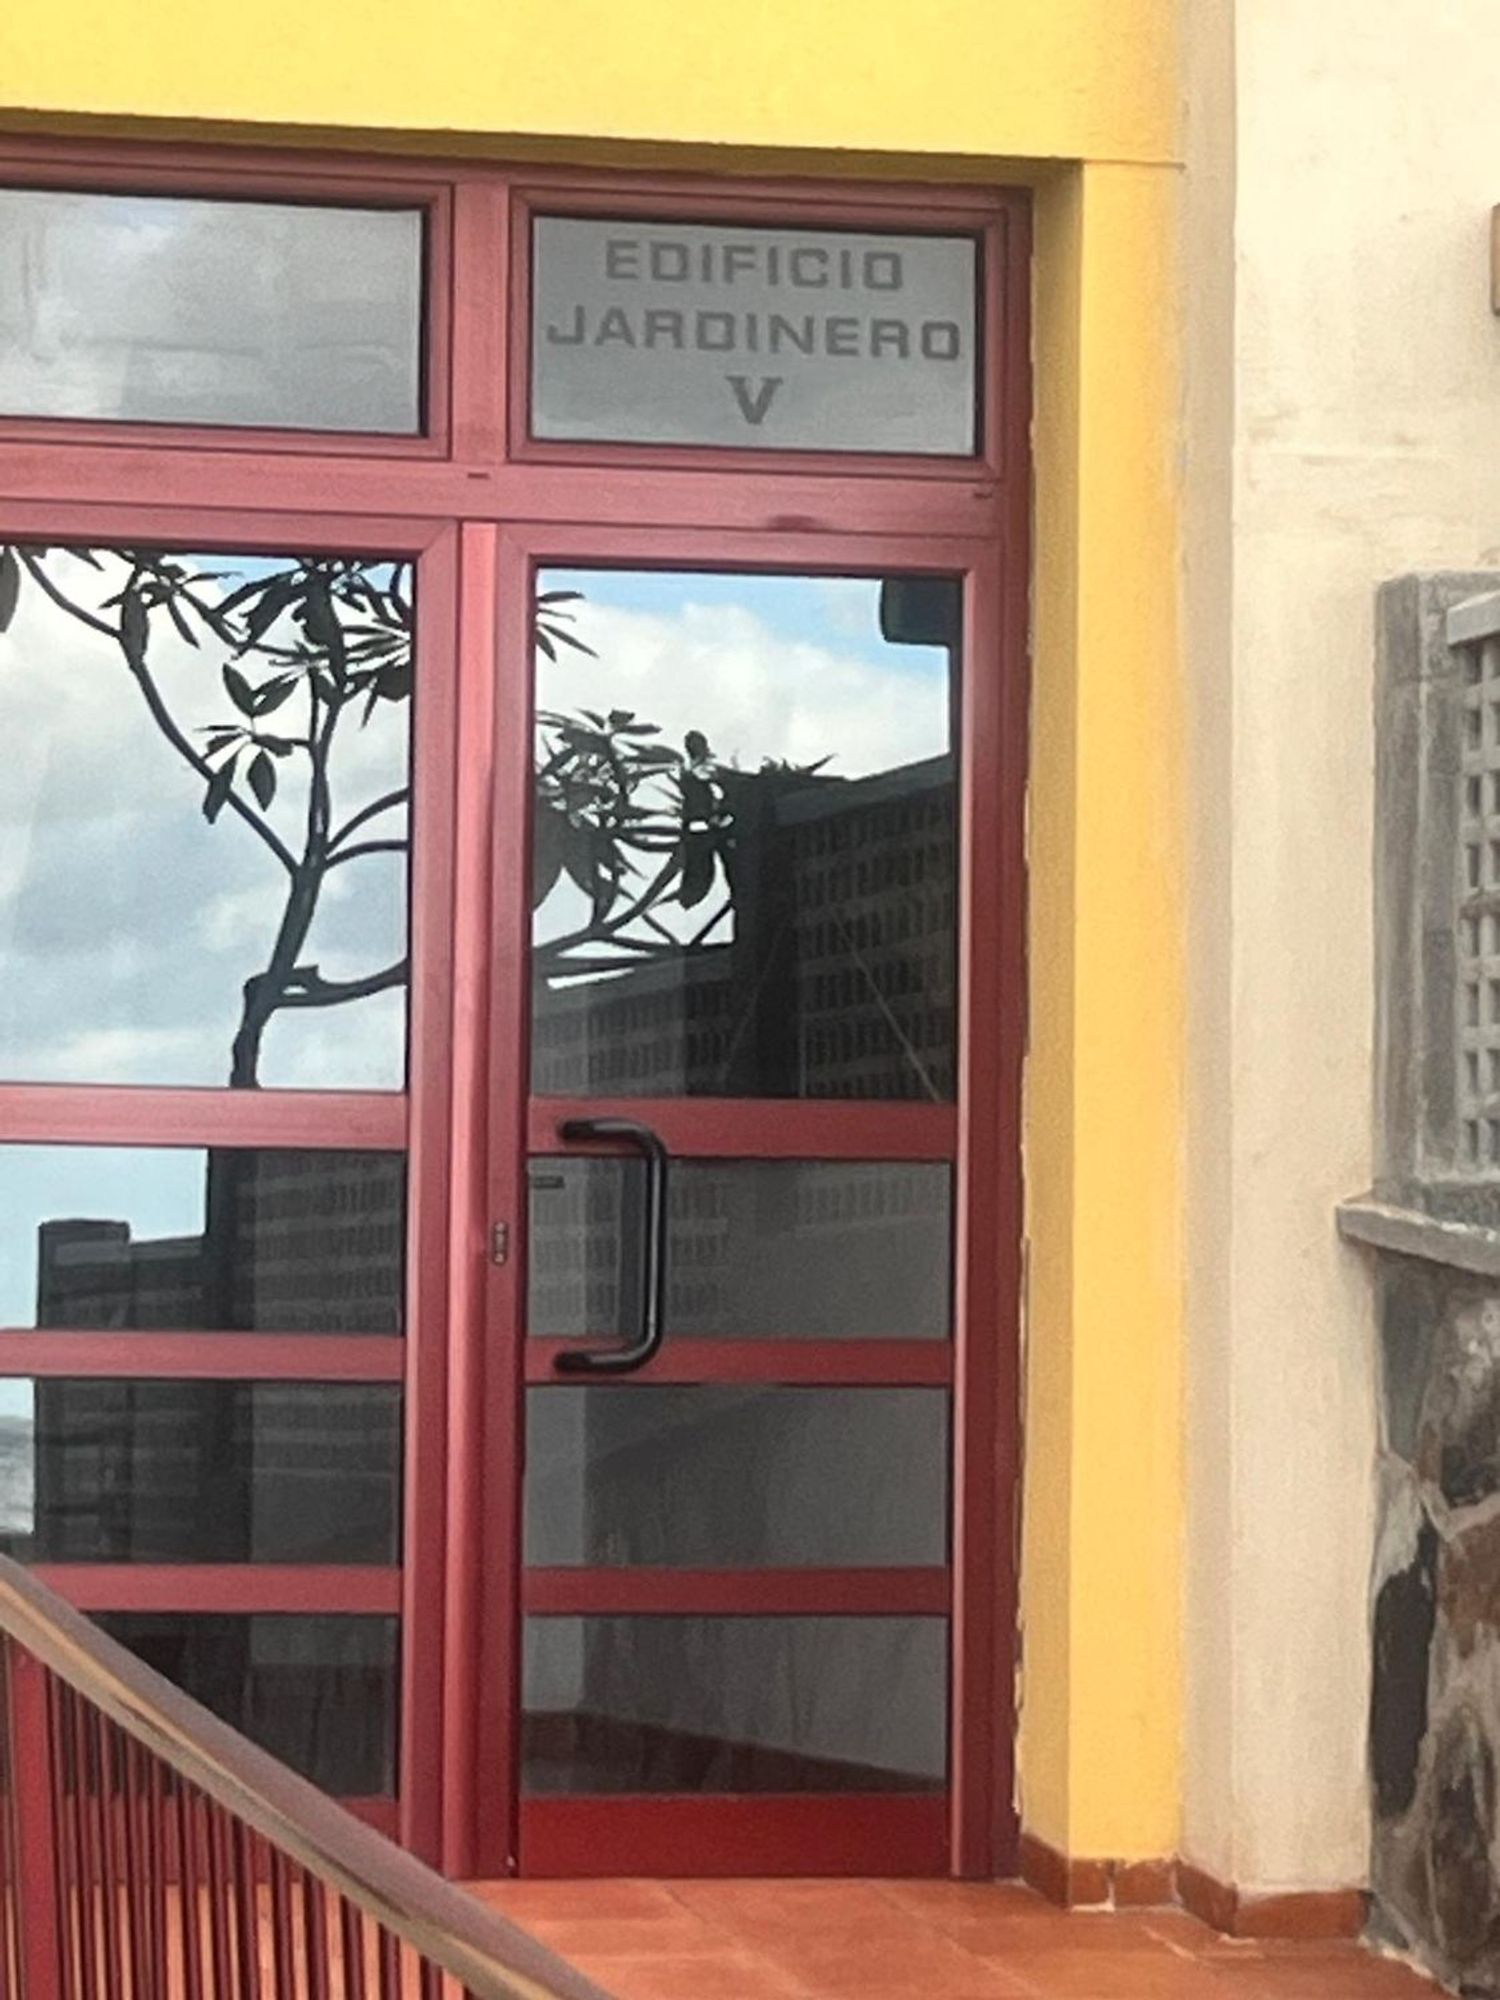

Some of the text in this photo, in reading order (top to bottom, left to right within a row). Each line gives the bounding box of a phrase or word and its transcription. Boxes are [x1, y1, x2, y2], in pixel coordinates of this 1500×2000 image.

[606, 239, 903, 291] EDIFICIO
[546, 305, 960, 361] JARDINERO
[724, 375, 784, 425] V
